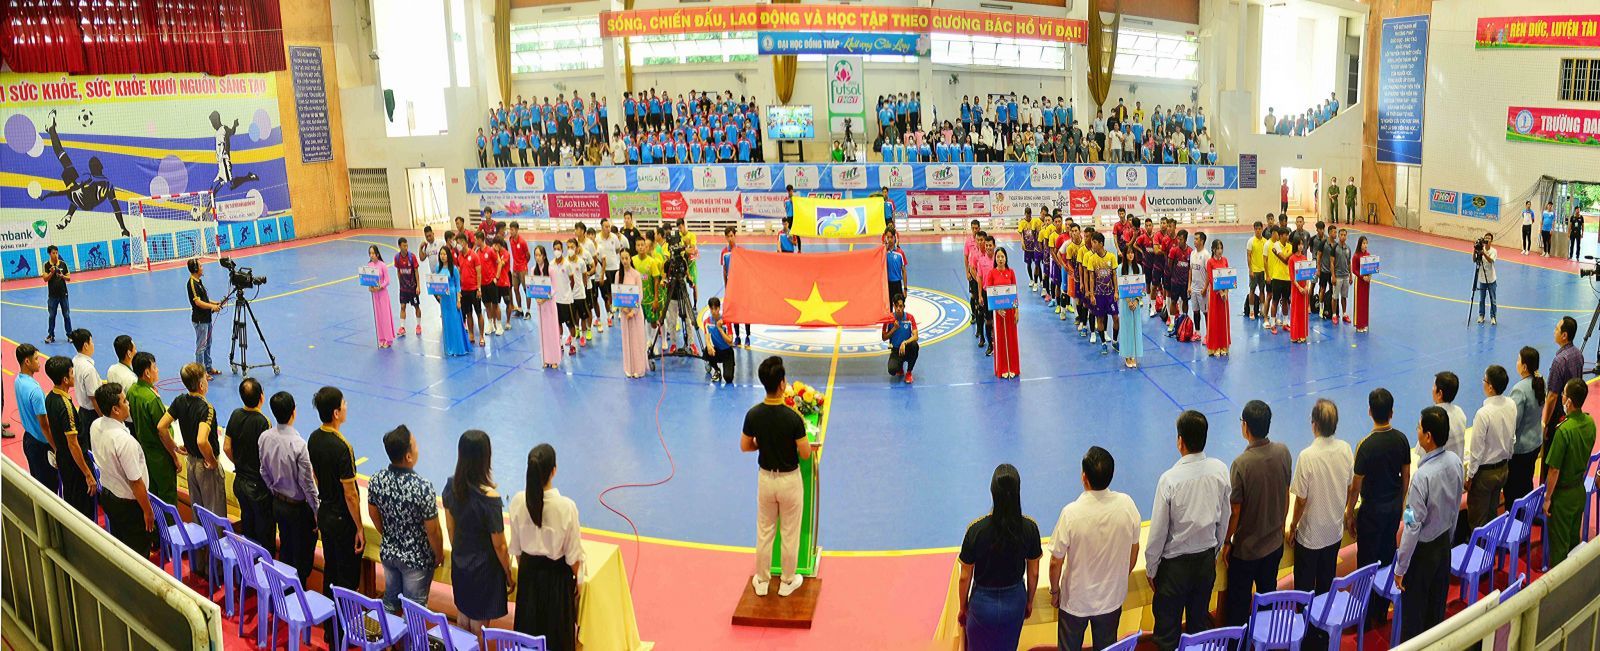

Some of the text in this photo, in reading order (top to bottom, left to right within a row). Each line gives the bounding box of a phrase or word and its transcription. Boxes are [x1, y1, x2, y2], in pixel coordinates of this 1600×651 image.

[607, 8, 1081, 40] SỐNG, CHIẾN ĐẤU, LAO ĐỘNG VÀ HỌC TẬP THEO GƯƠNG BÁC HỒ VĨ ĐẠI!
[1528, 20, 1549, 38] ĐỨC,
[1551, 19, 1579, 39] LUYỆN
[1581, 19, 1597, 37] TÀI
[777, 37, 840, 51] ĐẠI HỌC ĐỒNG THÁP
[9, 81, 38, 101] SỨC
[42, 77, 83, 100] KHỎE,
[85, 78, 111, 98] SỨC
[114, 76, 147, 97] KHỎE
[150, 78, 176, 95] KHƠI
[180, 75, 217, 94] NGUỒN
[219, 76, 247, 94] SÁNG
[250, 79, 266, 96] TẠO
[1541, 113, 1580, 133] TRƯỜNG
[1042, 171, 1057, 180] BẢNG
[564, 200, 600, 208] AGRIBANK
[1147, 196, 1202, 206] Vietcombank
